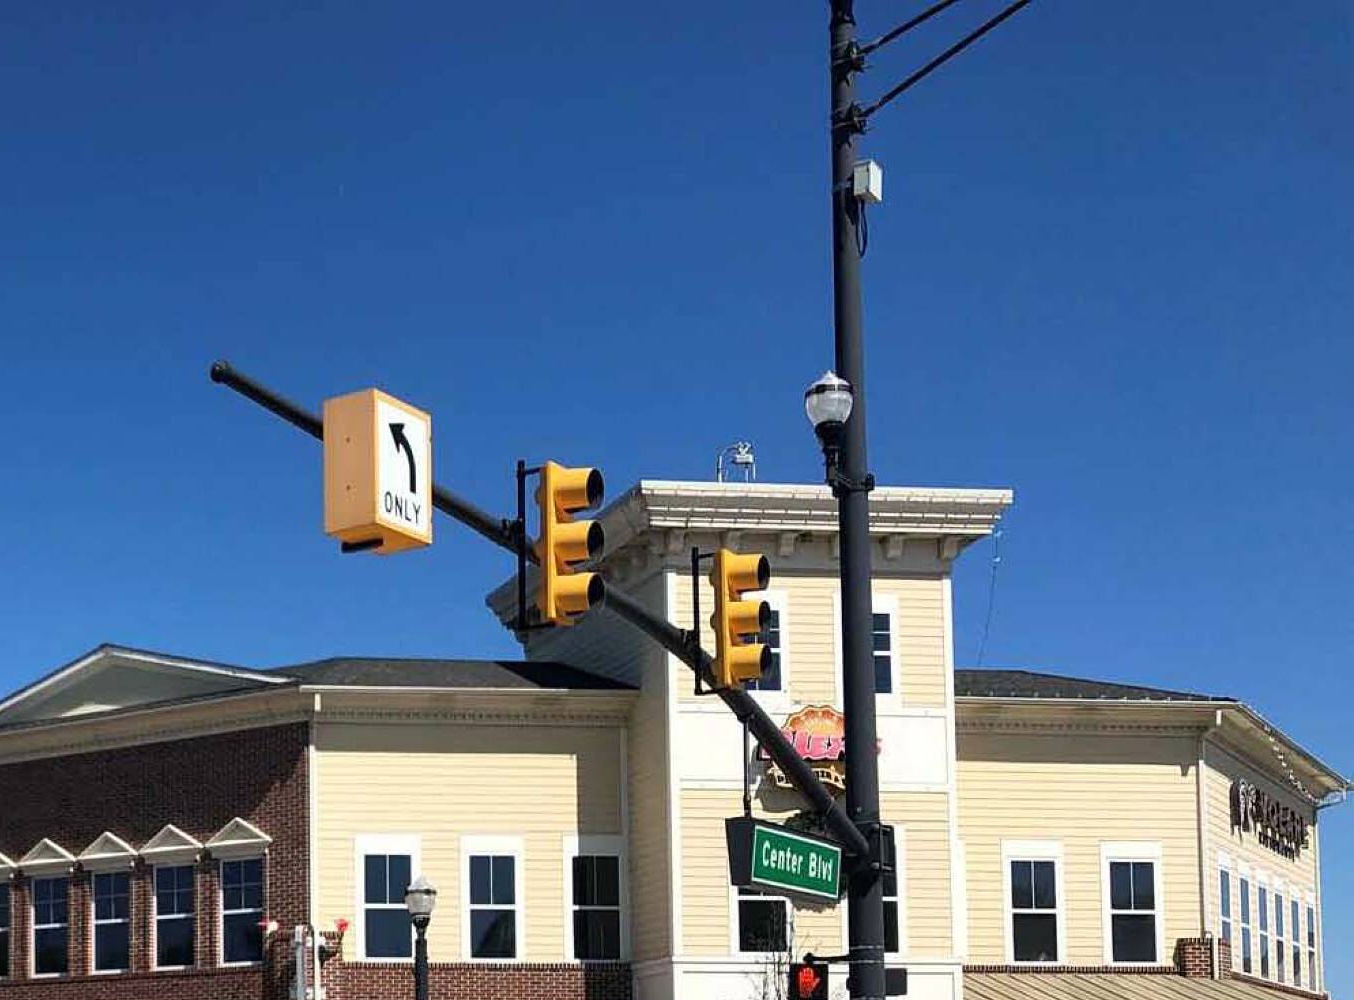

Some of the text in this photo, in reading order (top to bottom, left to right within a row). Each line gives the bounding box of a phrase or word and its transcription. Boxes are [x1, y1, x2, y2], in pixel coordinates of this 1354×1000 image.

[384, 491, 421, 523] ONLY
[762, 841, 833, 882] Center Blvd
